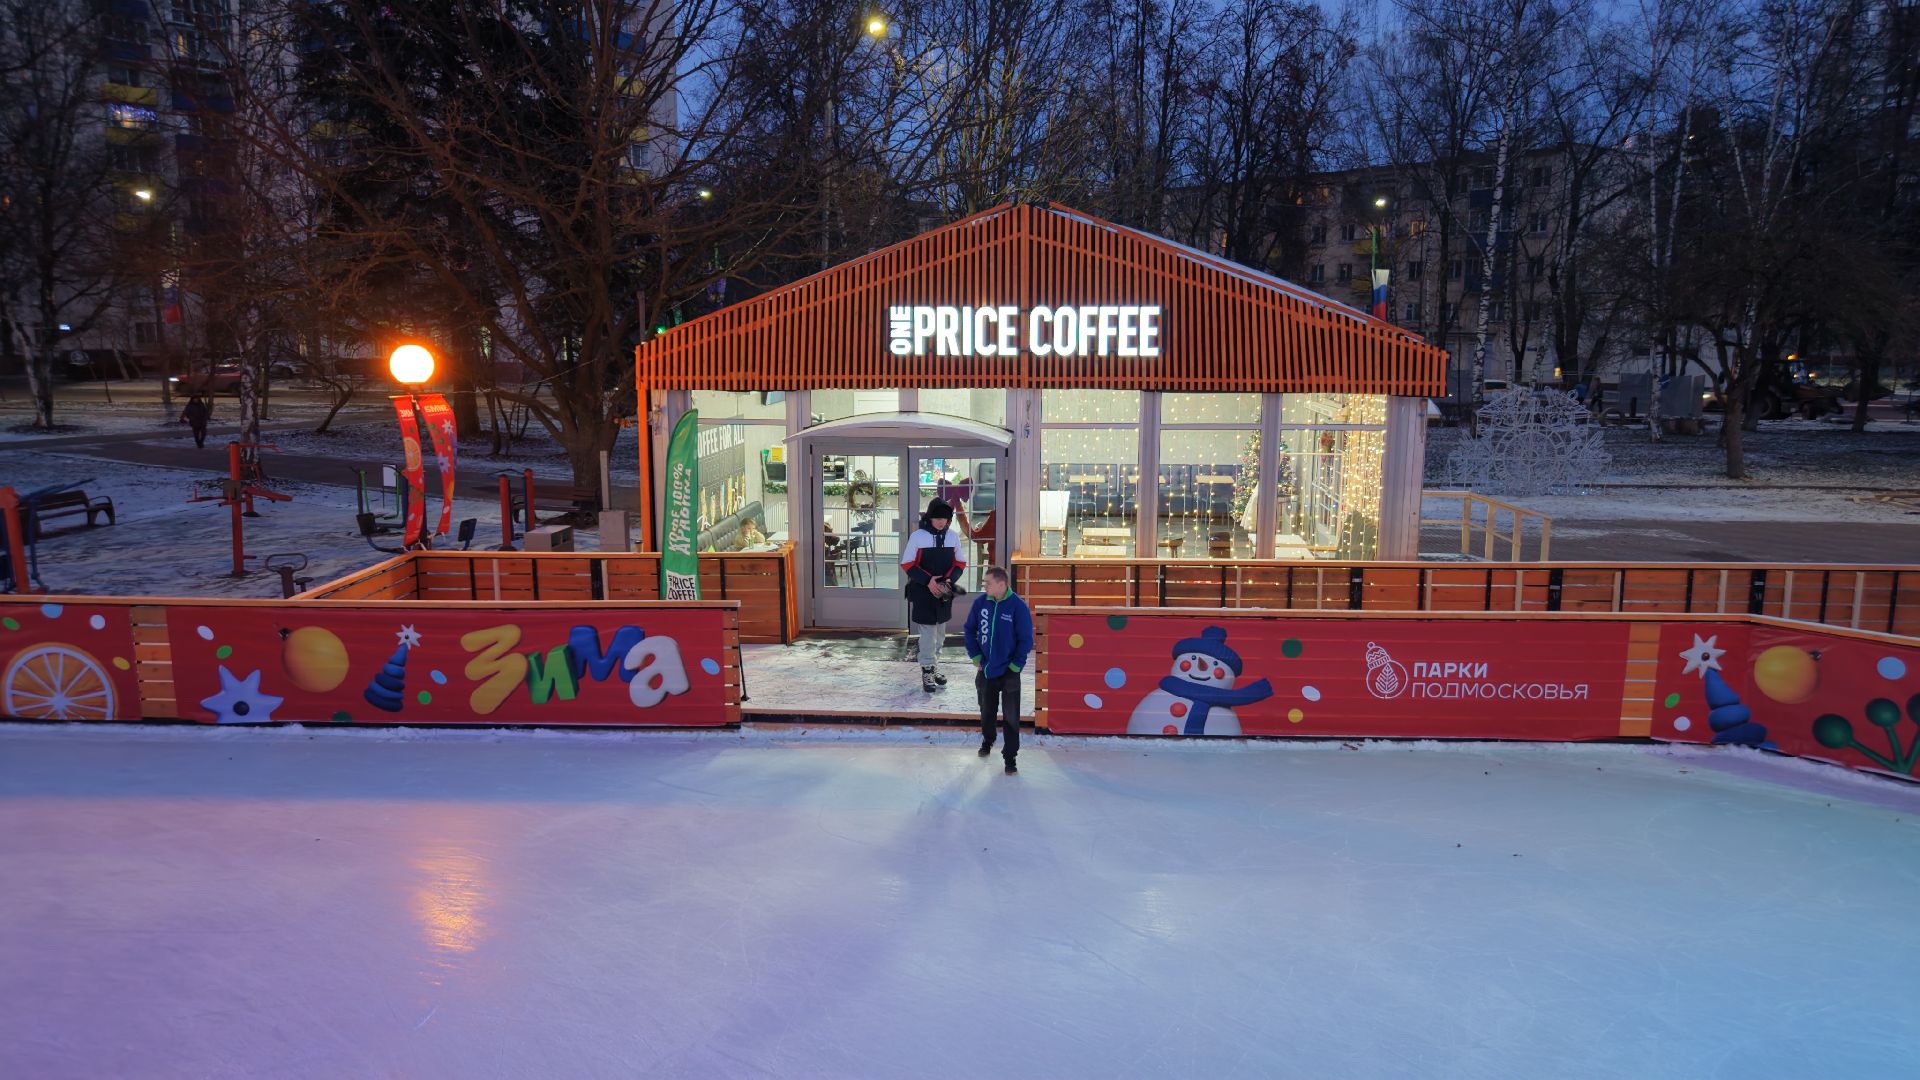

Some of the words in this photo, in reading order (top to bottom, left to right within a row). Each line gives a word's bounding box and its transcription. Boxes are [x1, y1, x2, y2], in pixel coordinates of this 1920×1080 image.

[890, 305, 913, 355] ONE
[913, 305, 1018, 356] PRICE
[1029, 305, 1161, 356] COFFEE
[697, 427, 719, 459] OFFEE
[719, 424, 732, 450] FOR
[733, 424, 745, 446] ALL
[672, 463, 684, 506] 100%
[1413, 662, 1489, 679] ПАРКИ
[1411, 682, 1589, 700] ПОДМОСКОВЬЯ
